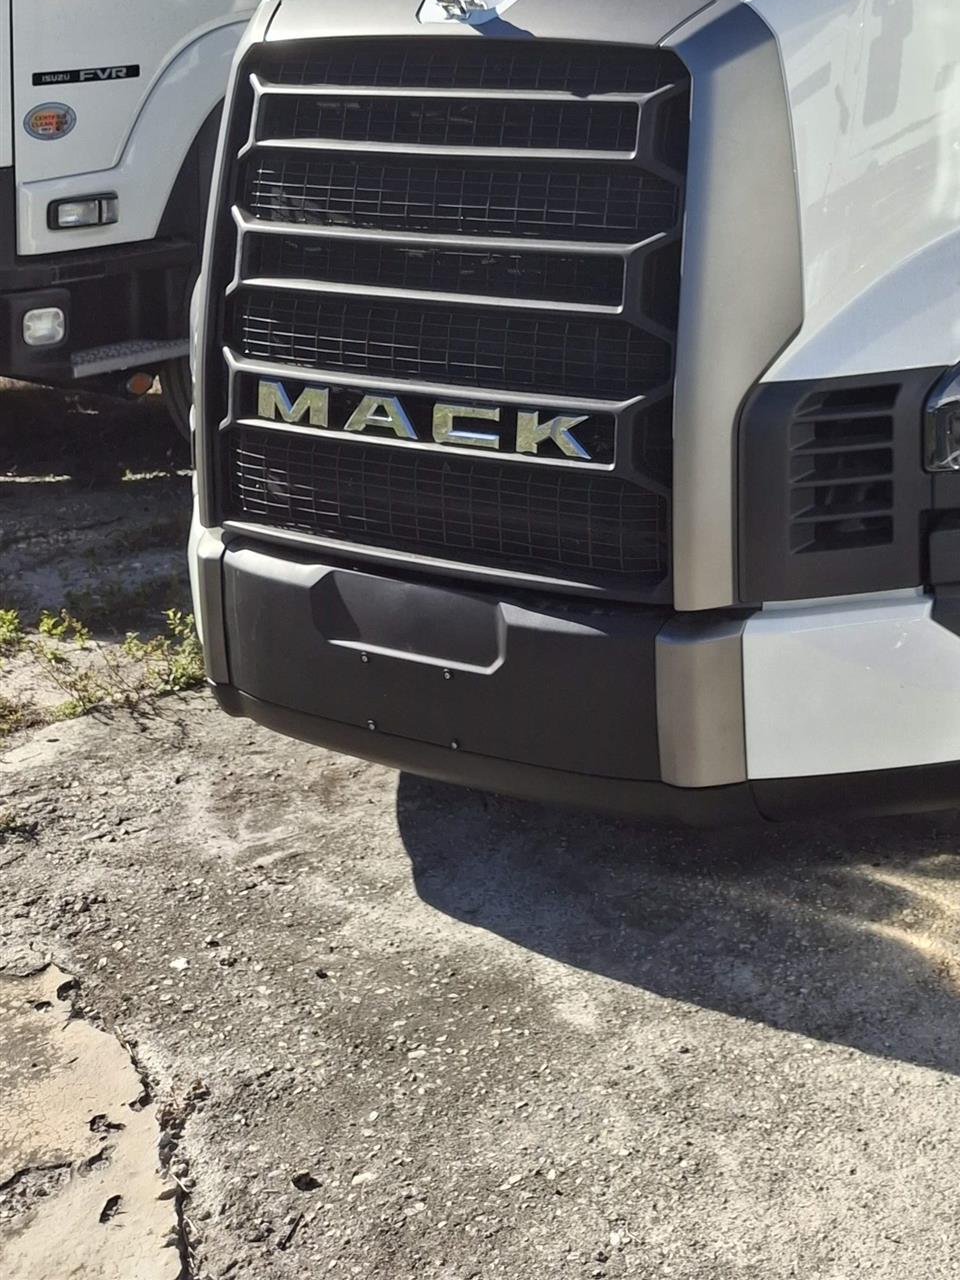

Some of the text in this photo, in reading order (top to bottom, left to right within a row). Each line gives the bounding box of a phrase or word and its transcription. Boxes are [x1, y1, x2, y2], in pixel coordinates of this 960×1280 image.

[41, 67, 127, 82] ISUZU FVR
[258, 378, 593, 460] MACK
